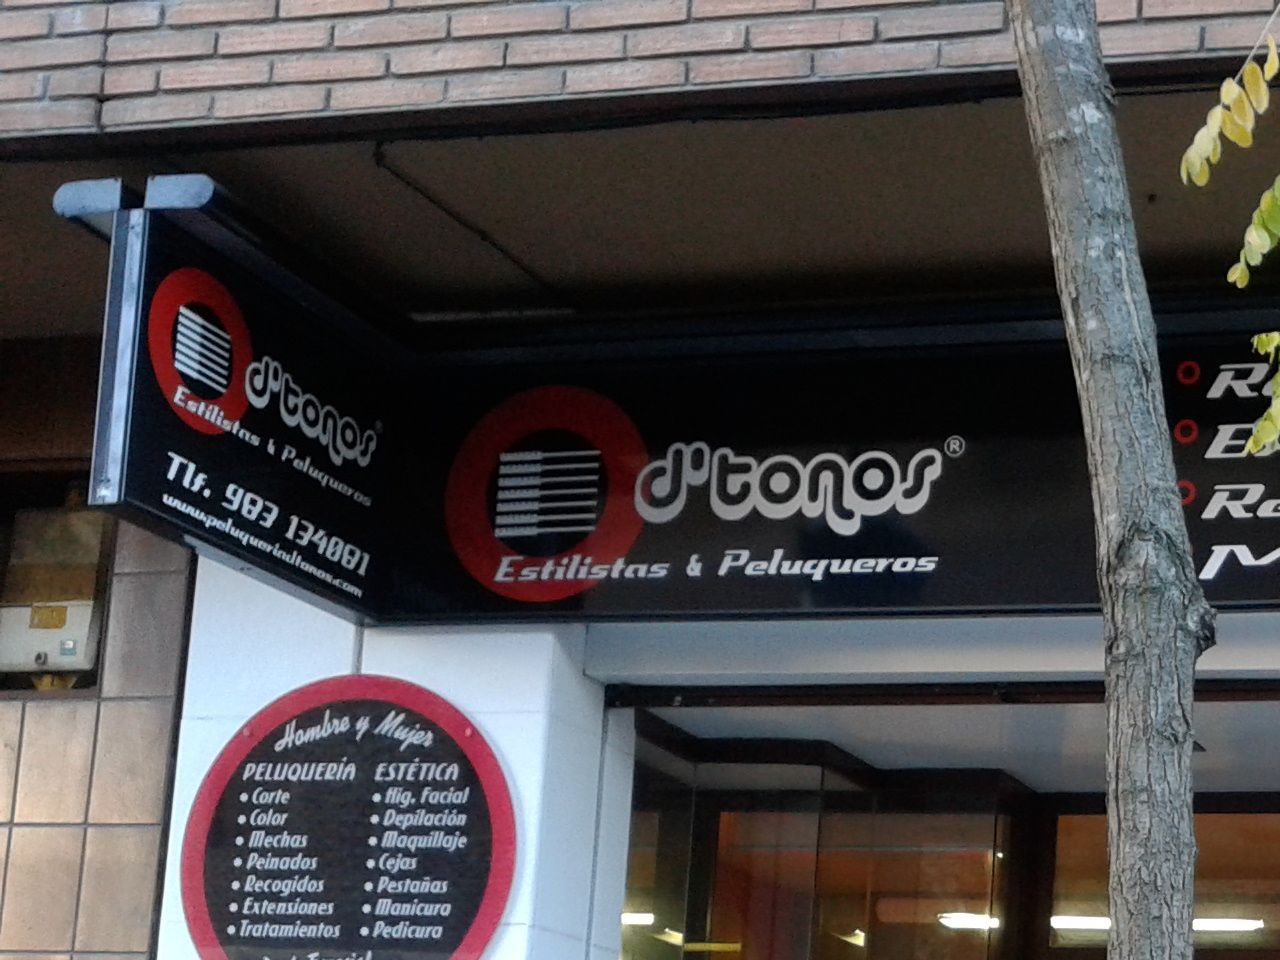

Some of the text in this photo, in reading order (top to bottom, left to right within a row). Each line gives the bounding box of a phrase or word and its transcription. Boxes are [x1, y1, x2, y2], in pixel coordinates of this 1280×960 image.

[173, 385, 260, 446] Estilistas
[281, 444, 372, 507] Peluqueros
[166, 452, 371, 577] Tlf. 983 134081
[162, 493, 363, 599] www.peluqueriadtonos.com
[494, 548, 939, 583] Estilistas & Peluqueros
[274, 709, 434, 752] Hombre y Mujer
[243, 757, 357, 783] PELUQUERÍA
[374, 757, 460, 782] ESTÉTICA
[252, 786, 291, 805] Corte
[384, 786, 471, 808] Hig. Facial
[249, 808, 289, 826] Color
[382, 808, 468, 831] Depilación
[248, 830, 309, 848] Mechas
[380, 830, 468, 852] Maquillaje
[246, 852, 319, 871] Peinados
[378, 853, 418, 874] Cejas
[243, 874, 325, 897] Recogidos
[376, 876, 449, 894] Pestañas
[242, 896, 335, 916] Extensiones
[374, 898, 452, 917] Manicura
[239, 919, 342, 939] Tratamientos
[372, 920, 444, 939] Pedicura
